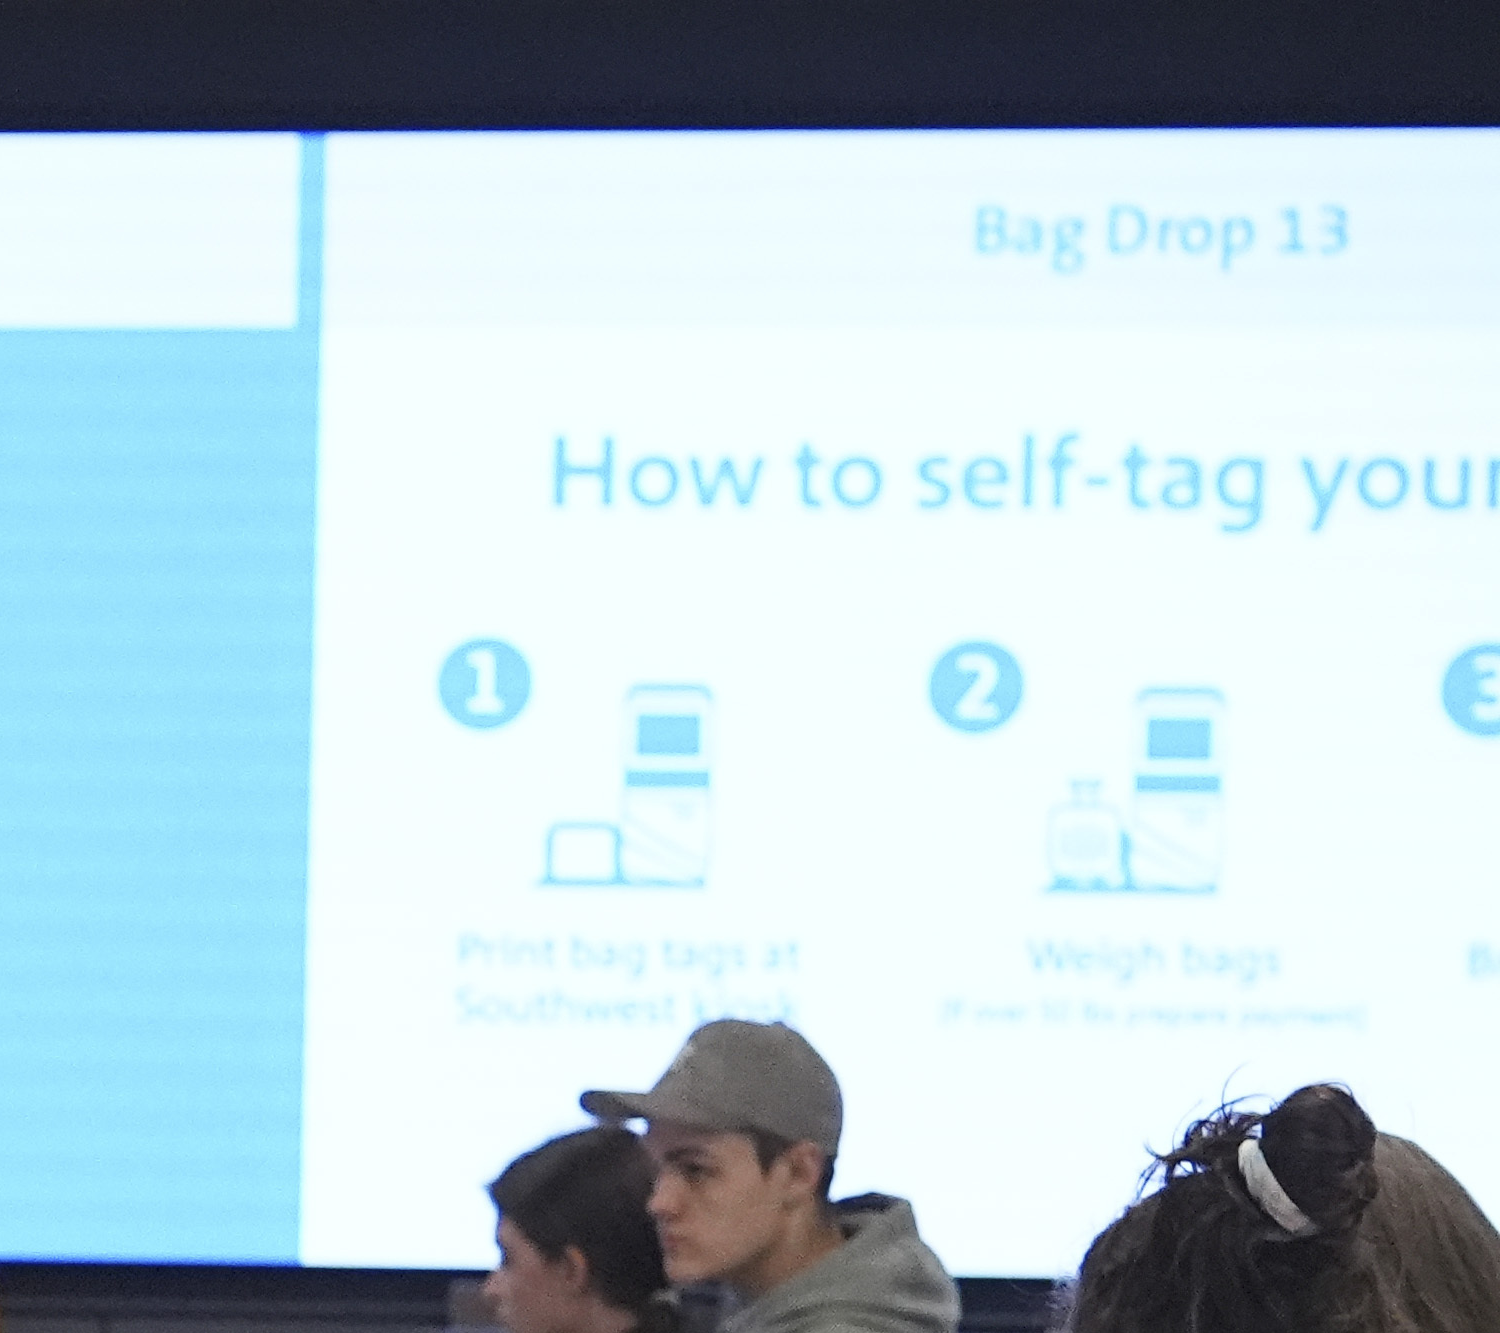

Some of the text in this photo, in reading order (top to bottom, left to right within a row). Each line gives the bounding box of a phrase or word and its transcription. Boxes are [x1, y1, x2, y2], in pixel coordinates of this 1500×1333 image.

[973, 202, 1352, 276] Bag Drop 13
[550, 433, 766, 511] How
[792, 440, 886, 511] to
[914, 429, 1268, 537] self-tag
[464, 647, 504, 716] 1
[955, 651, 1000, 721] 2
